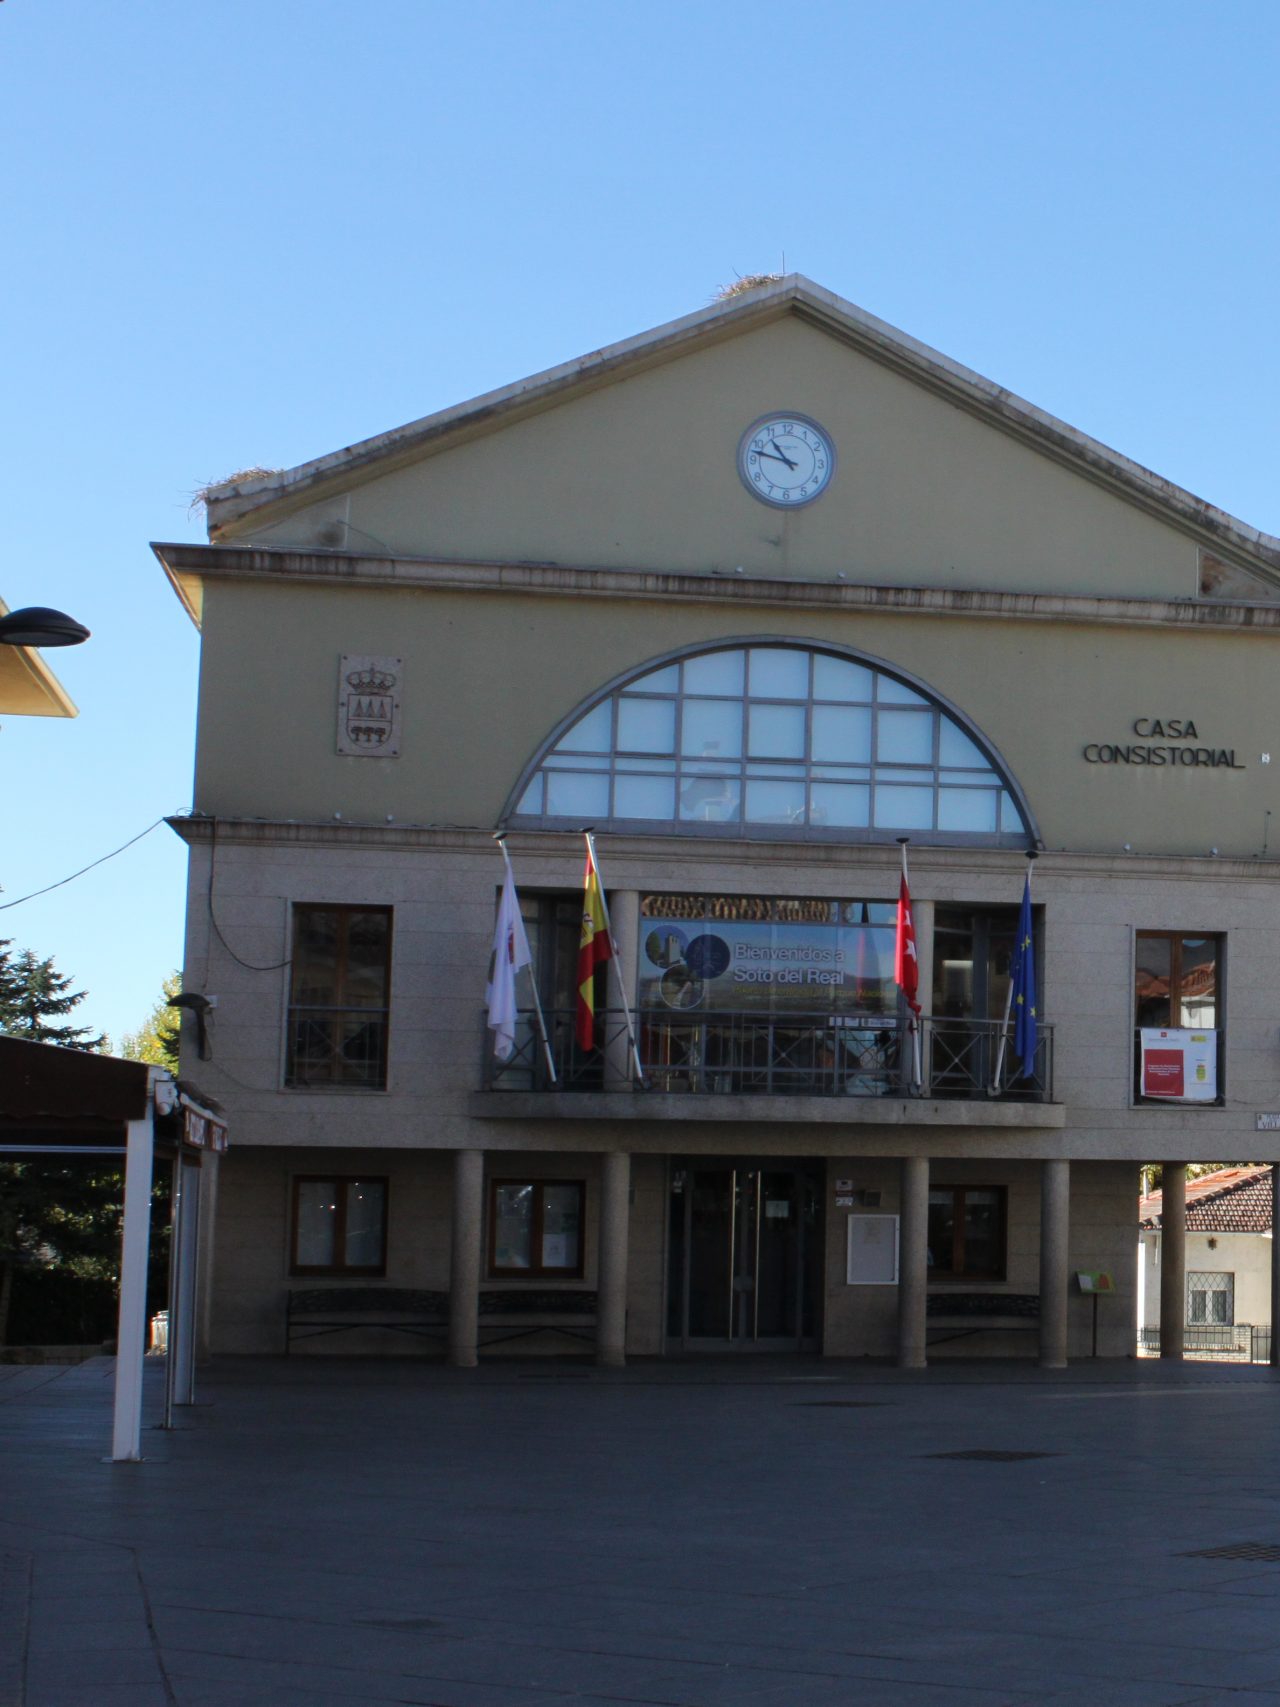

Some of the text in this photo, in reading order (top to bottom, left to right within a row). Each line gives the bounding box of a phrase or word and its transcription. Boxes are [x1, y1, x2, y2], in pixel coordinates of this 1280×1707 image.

[782, 424, 794, 434] 12
[813, 442, 820, 452] 2
[818, 460, 825, 469] 3
[812, 476, 819, 485] 4
[783, 490, 790, 500] 6
[800, 487, 807, 496] 5
[1133, 718, 1198, 739] CASA
[1083, 743, 1246, 769] CONSISTORIAL
[735, 943, 845, 962] Bienvenidos a
[734, 967, 844, 985] Soto del Real
